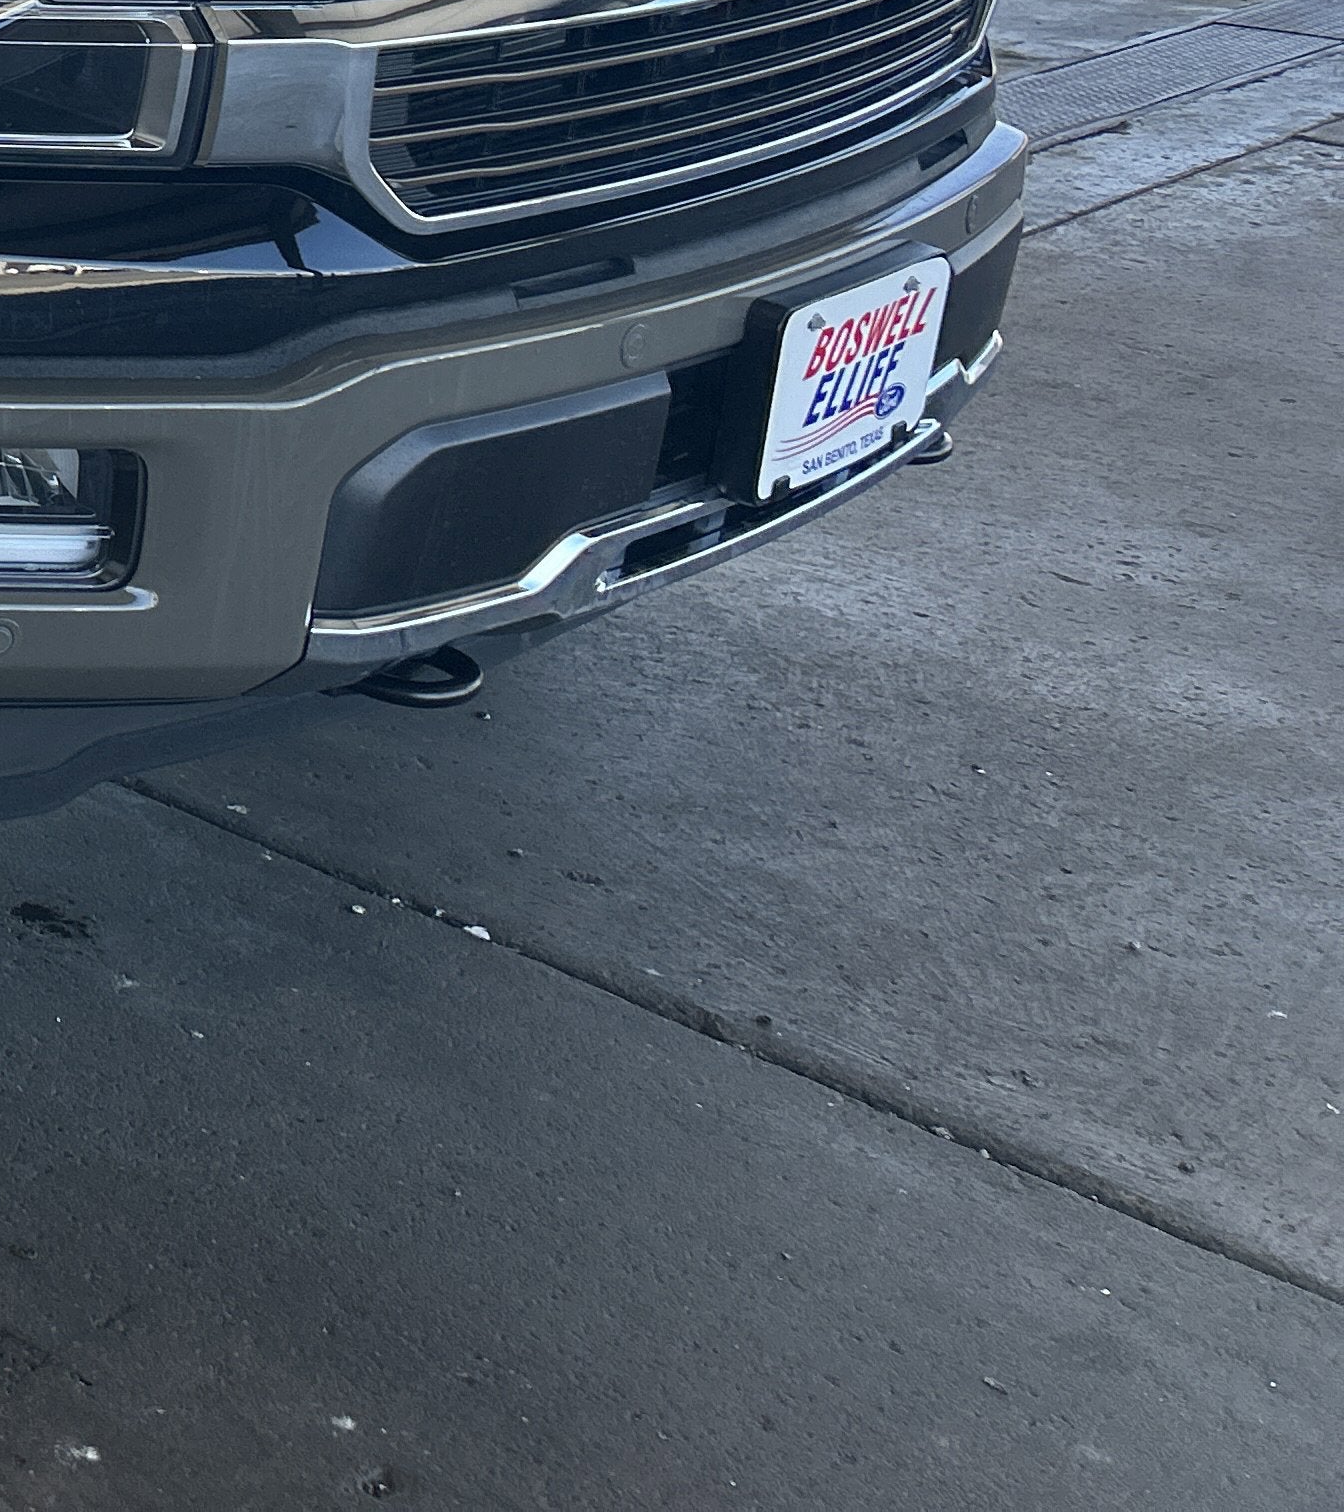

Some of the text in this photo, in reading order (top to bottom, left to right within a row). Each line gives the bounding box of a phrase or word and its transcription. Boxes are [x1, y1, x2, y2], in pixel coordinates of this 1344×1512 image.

[802, 287, 938, 381] BOSWELL
[802, 342, 905, 428] ELLIFF
[802, 454, 824, 475] SAN
[860, 425, 884, 449] TEXAS
